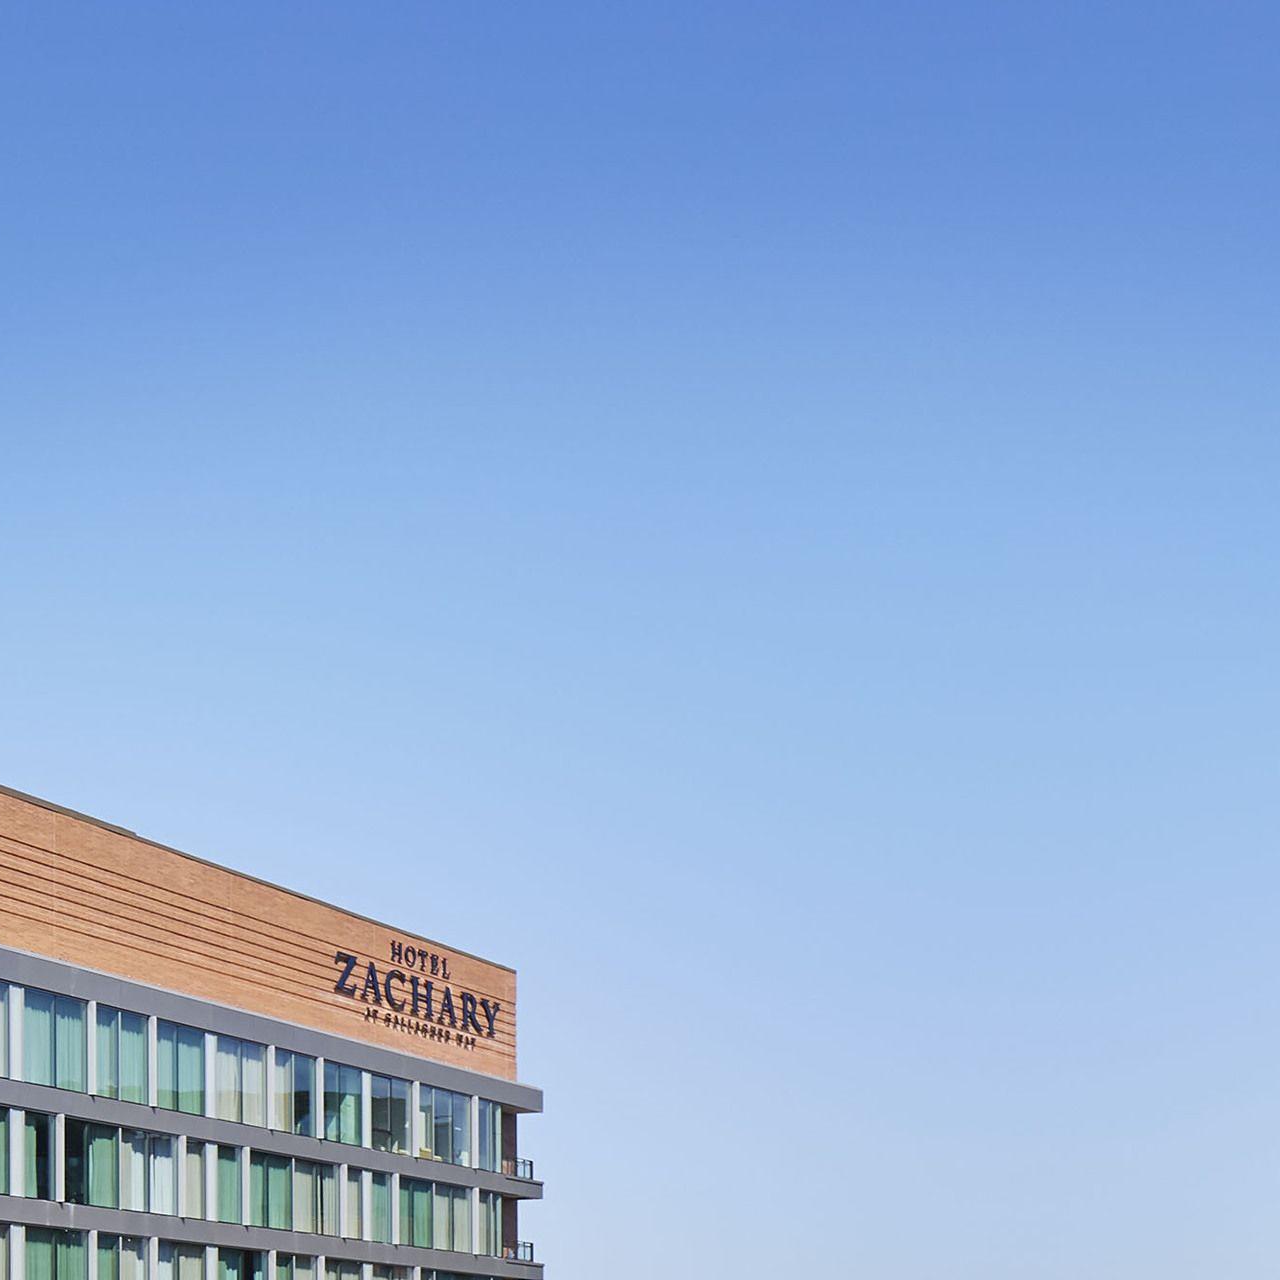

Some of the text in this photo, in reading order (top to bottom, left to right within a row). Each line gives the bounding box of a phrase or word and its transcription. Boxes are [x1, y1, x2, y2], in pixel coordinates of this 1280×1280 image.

[390, 940, 451, 980] HOTEL
[334, 951, 500, 1038] ZACHARY
[364, 1007, 378, 1023] AT
[384, 1012, 451, 1044] GALLAGHER
